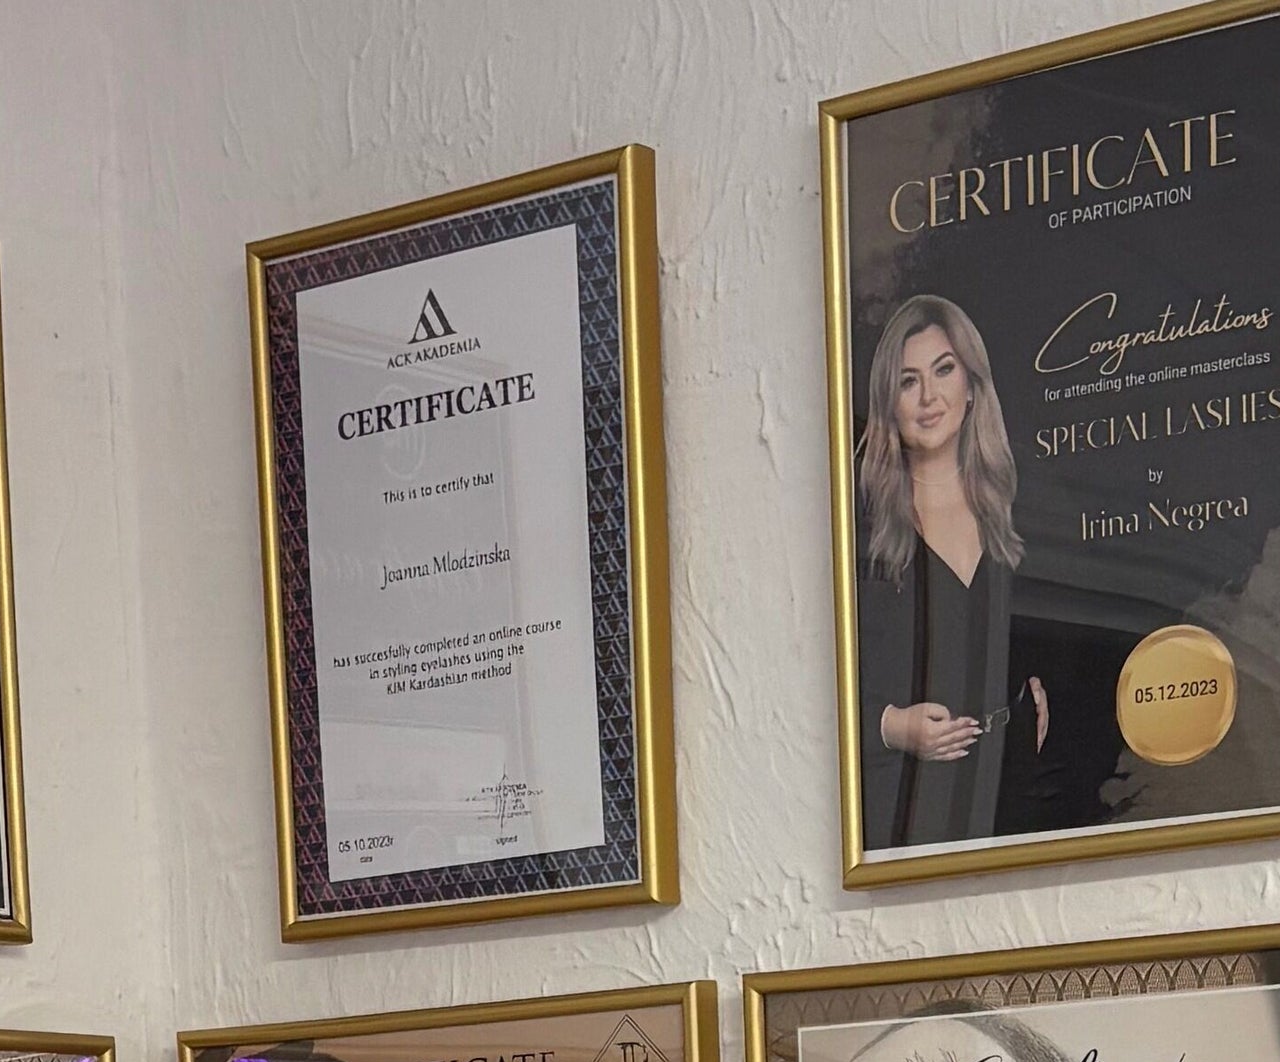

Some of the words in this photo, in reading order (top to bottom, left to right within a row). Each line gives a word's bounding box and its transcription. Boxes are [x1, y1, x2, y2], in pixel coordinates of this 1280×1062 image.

[889, 110, 1236, 233] CERTIFICATE
[1048, 210, 1068, 229] OF
[1072, 185, 1192, 224] PARTICIPATION
[387, 353, 412, 369] ACK
[415, 338, 481, 362] AKADEMIA
[1035, 292, 1274, 374] Congratulations
[1044, 387, 1061, 401] for
[1064, 377, 1121, 399] attending
[1125, 372, 1146, 387] the
[1149, 364, 1187, 384] online
[1190, 351, 1271, 376] masterclass
[338, 373, 535, 440] CERTIFICATE
[1036, 412, 1156, 459] SPECIAL
[384, 491, 404, 503] This
[408, 488, 417, 499] is
[421, 485, 432, 496] to
[435, 477, 469, 494] certify
[473, 473, 494, 486] that
[1149, 469, 1163, 484] by
[1082, 509, 1140, 540] Irina
[1148, 496, 1248, 532] Negrea
[380, 564, 430, 590] Joanna
[433, 542, 510, 574] Mlodzinska
[1135, 679, 1218, 704] 05.12.2023
